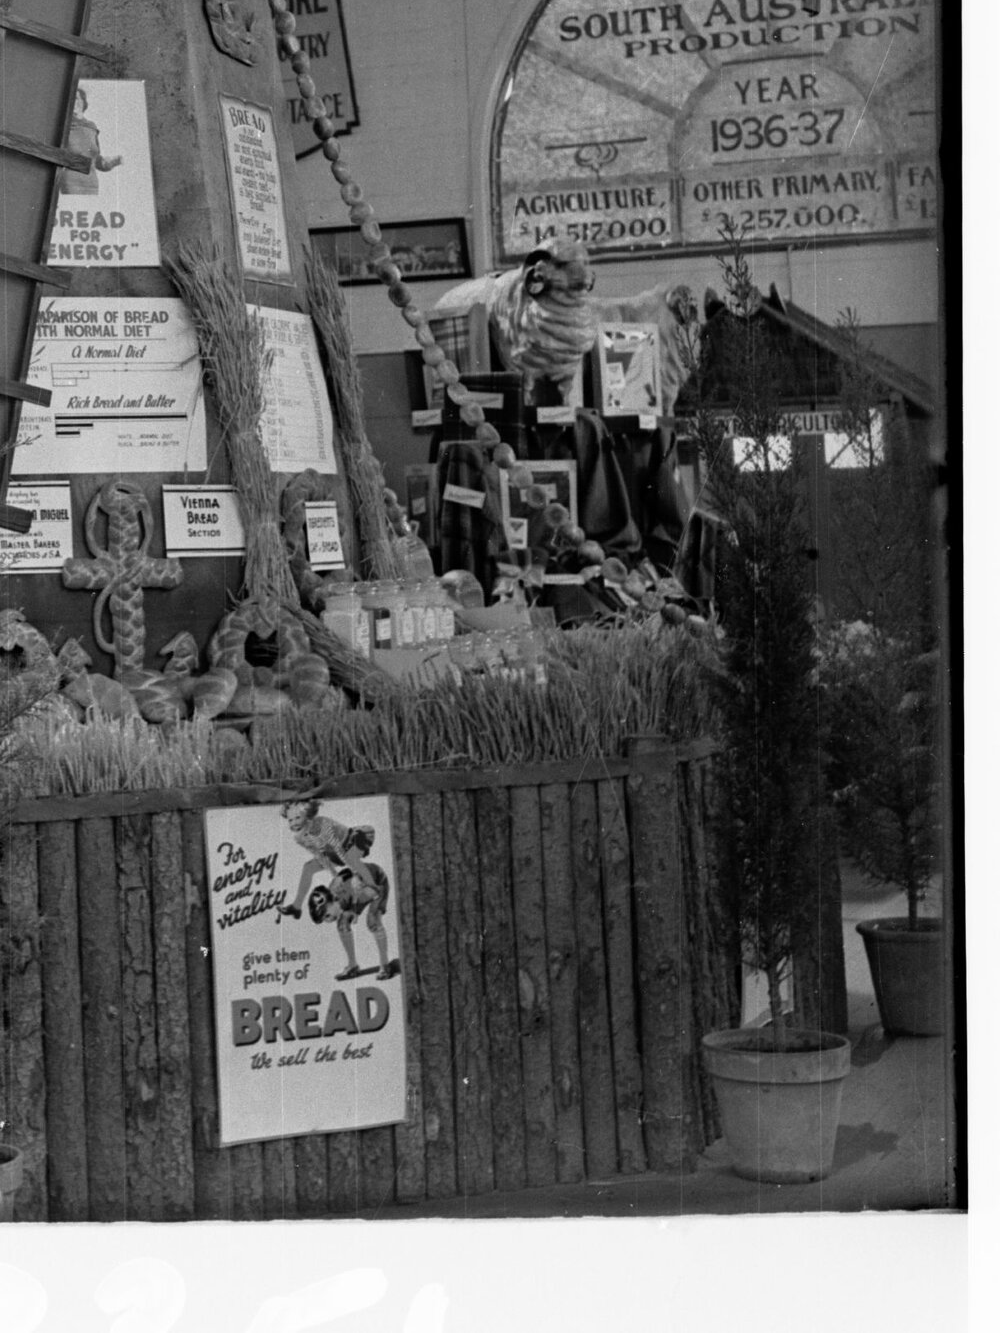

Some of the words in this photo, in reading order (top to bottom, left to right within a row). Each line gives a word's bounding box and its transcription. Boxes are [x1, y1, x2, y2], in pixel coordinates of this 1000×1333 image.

[559, 4, 684, 42] SOUTH
[624, 13, 921, 58] PRODUCTION
[734, 74, 819, 105] YEAR
[229, 106, 266, 133] BREAD
[711, 110, 845, 153] 1936-37
[515, 186, 665, 217] AGRICULTURE,
[693, 178, 764, 203] OTHER
[55, 211, 125, 229] READ
[70, 230, 101, 242] FOR
[37, 310, 98, 324] MPARISON
[104, 310, 119, 324] OF
[123, 310, 169, 324] BREAD
[37, 325, 58, 338] ITH
[64, 325, 119, 338] NORMAL
[123, 325, 153, 338] DIET
[85, 344, 123, 358] Normal
[125, 344, 147, 358] Diet
[92, 394, 122, 409] Bread
[122, 394, 143, 408] and
[187, 511, 219, 524] BREAD
[216, 842, 247, 866] For
[212, 852, 279, 892] energy
[224, 878, 254, 905] and
[216, 890, 288, 930] vitality
[242, 952, 272, 971] give
[275, 948, 311, 964] them
[243, 968, 290, 990] plenty
[294, 963, 311, 980] of
[231, 986, 390, 1048] BREAD
[250, 1052, 273, 1071] We
[277, 1047, 310, 1067] sell
[314, 1044, 337, 1062] the
[341, 1042, 374, 1060] best
